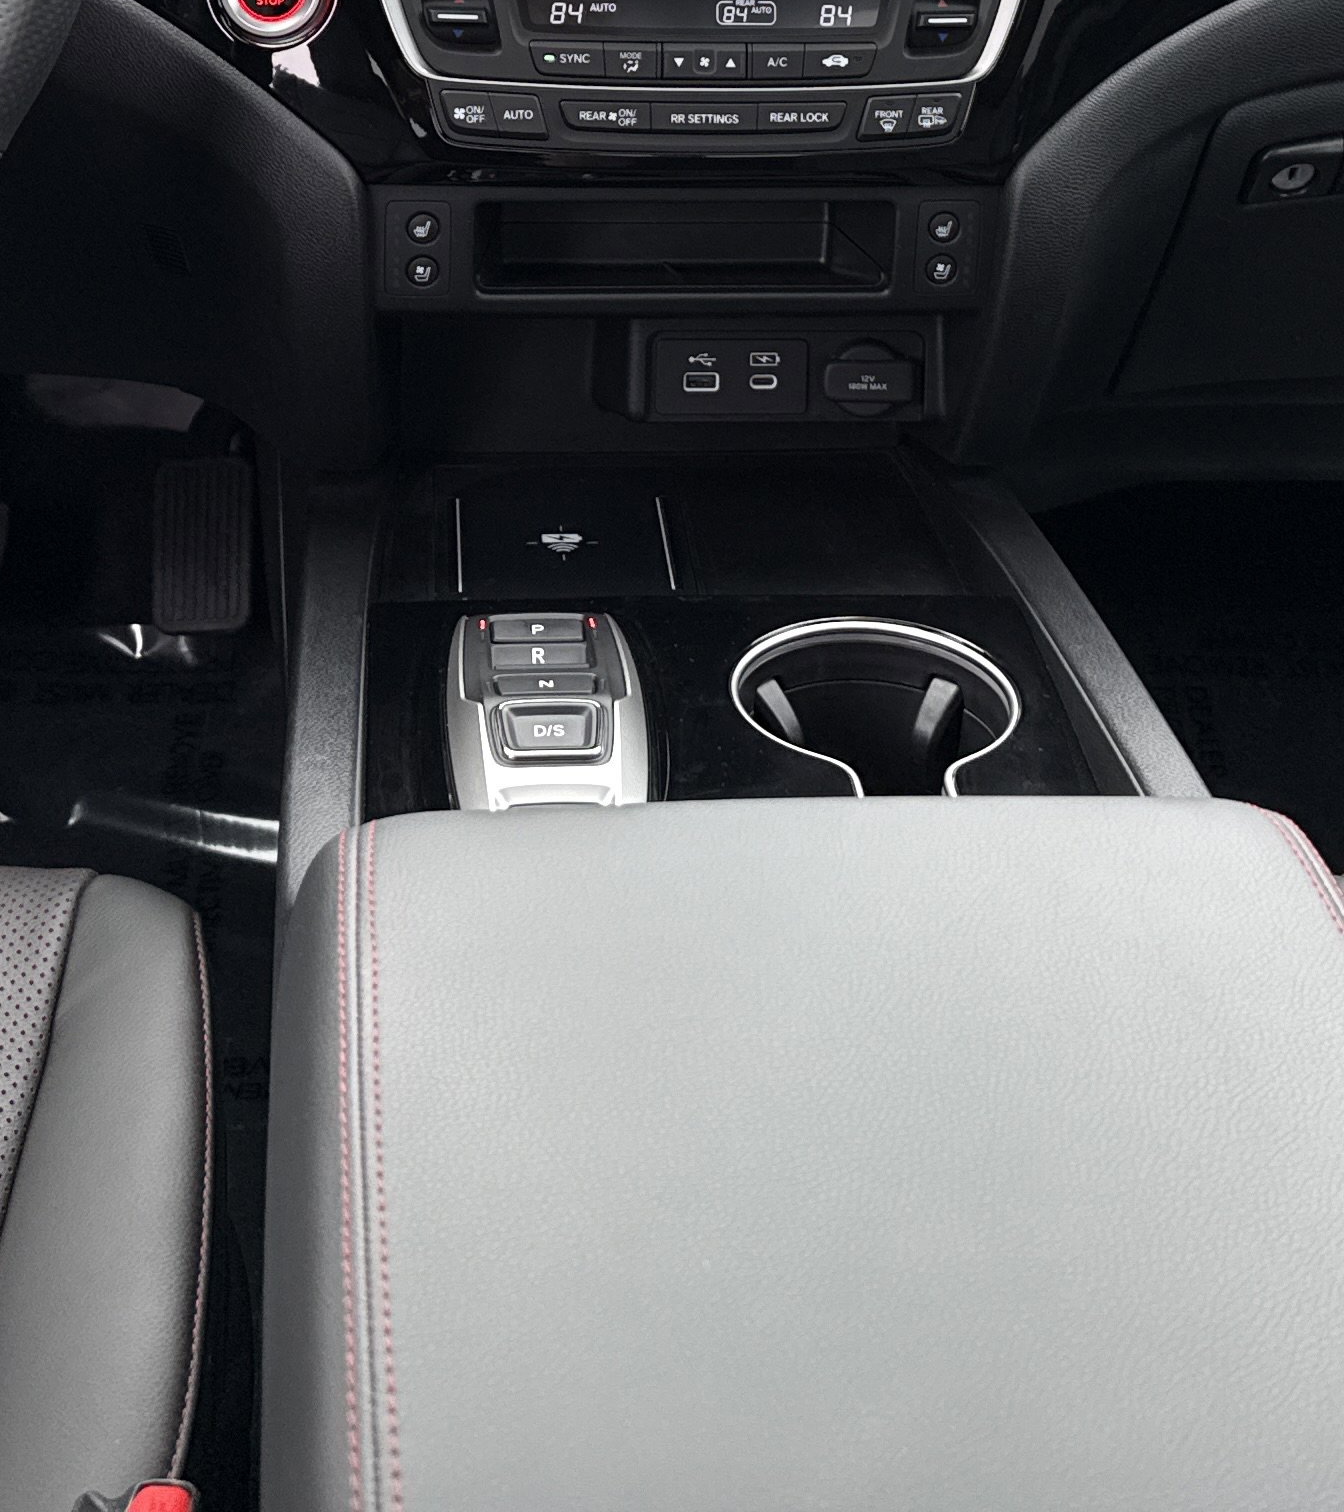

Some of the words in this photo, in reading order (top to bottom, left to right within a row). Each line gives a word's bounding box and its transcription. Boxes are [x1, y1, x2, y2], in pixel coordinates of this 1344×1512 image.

[549, 2, 584, 25] 84
[589, 3, 617, 13] AUTO
[722, 6, 748, 23] 84
[750, 7, 772, 15] AUTO
[819, 4, 853, 27] 84
[559, 53, 591, 64] SYNC
[619, 52, 642, 60] MODE
[767, 56, 788, 68] A/C
[465, 105, 485, 115] ON/
[503, 109, 533, 120] AUTO
[579, 110, 607, 121] REAR
[617, 108, 637, 118] ON/
[874, 109, 904, 119] FRONT
[921, 107, 944, 115] REAR
[465, 114, 485, 124] OFF
[617, 117, 638, 127] OFF
[670, 113, 687, 124] RR
[688, 113, 740, 125] SETTINGS
[769, 112, 797, 123] REAR
[800, 112, 829, 123] LOCK
[531, 624, 544, 635] P
[531, 647, 546, 664] R
[538, 679, 555, 688] N
[533, 724, 565, 737] D/S
